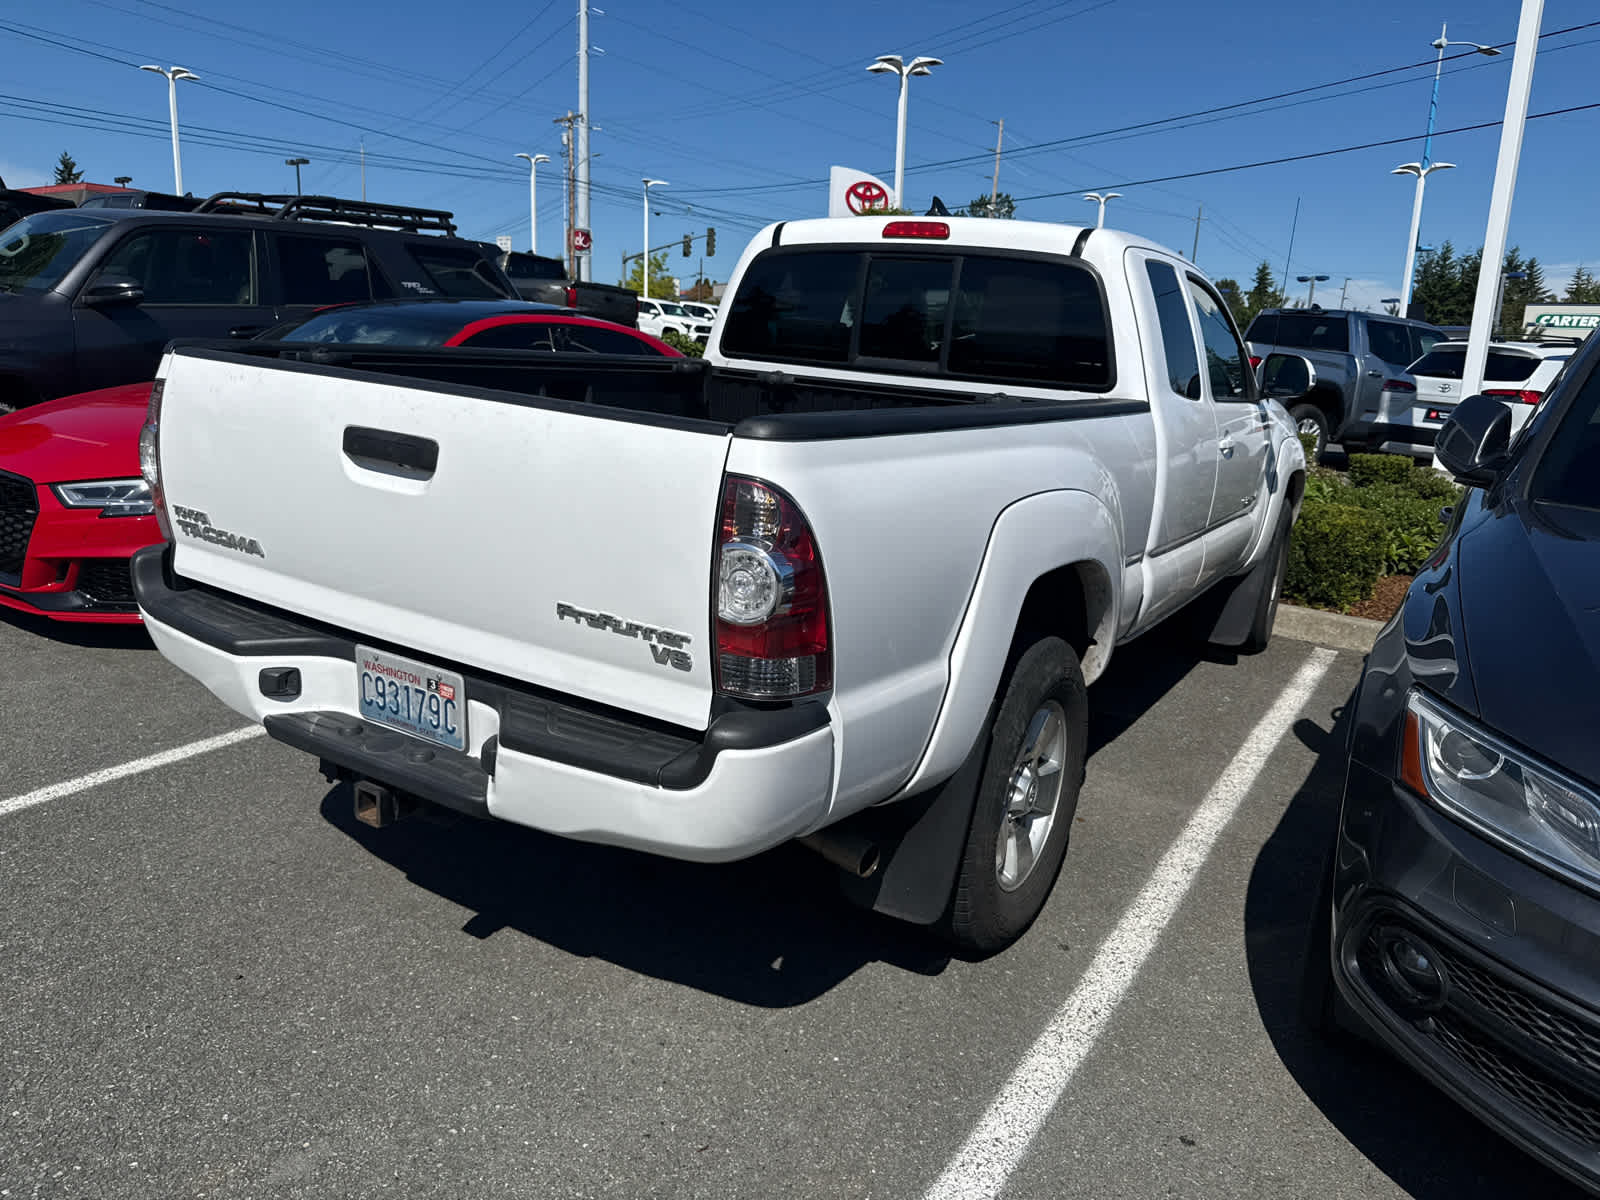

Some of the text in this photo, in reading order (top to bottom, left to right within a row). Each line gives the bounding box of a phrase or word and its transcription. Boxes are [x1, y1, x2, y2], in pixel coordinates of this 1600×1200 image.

[1540, 315, 1600, 327] CARTER
[176, 519, 265, 559] TACOMA
[363, 660, 421, 686] WASHINGTON
[362, 672, 457, 735] C93179C
